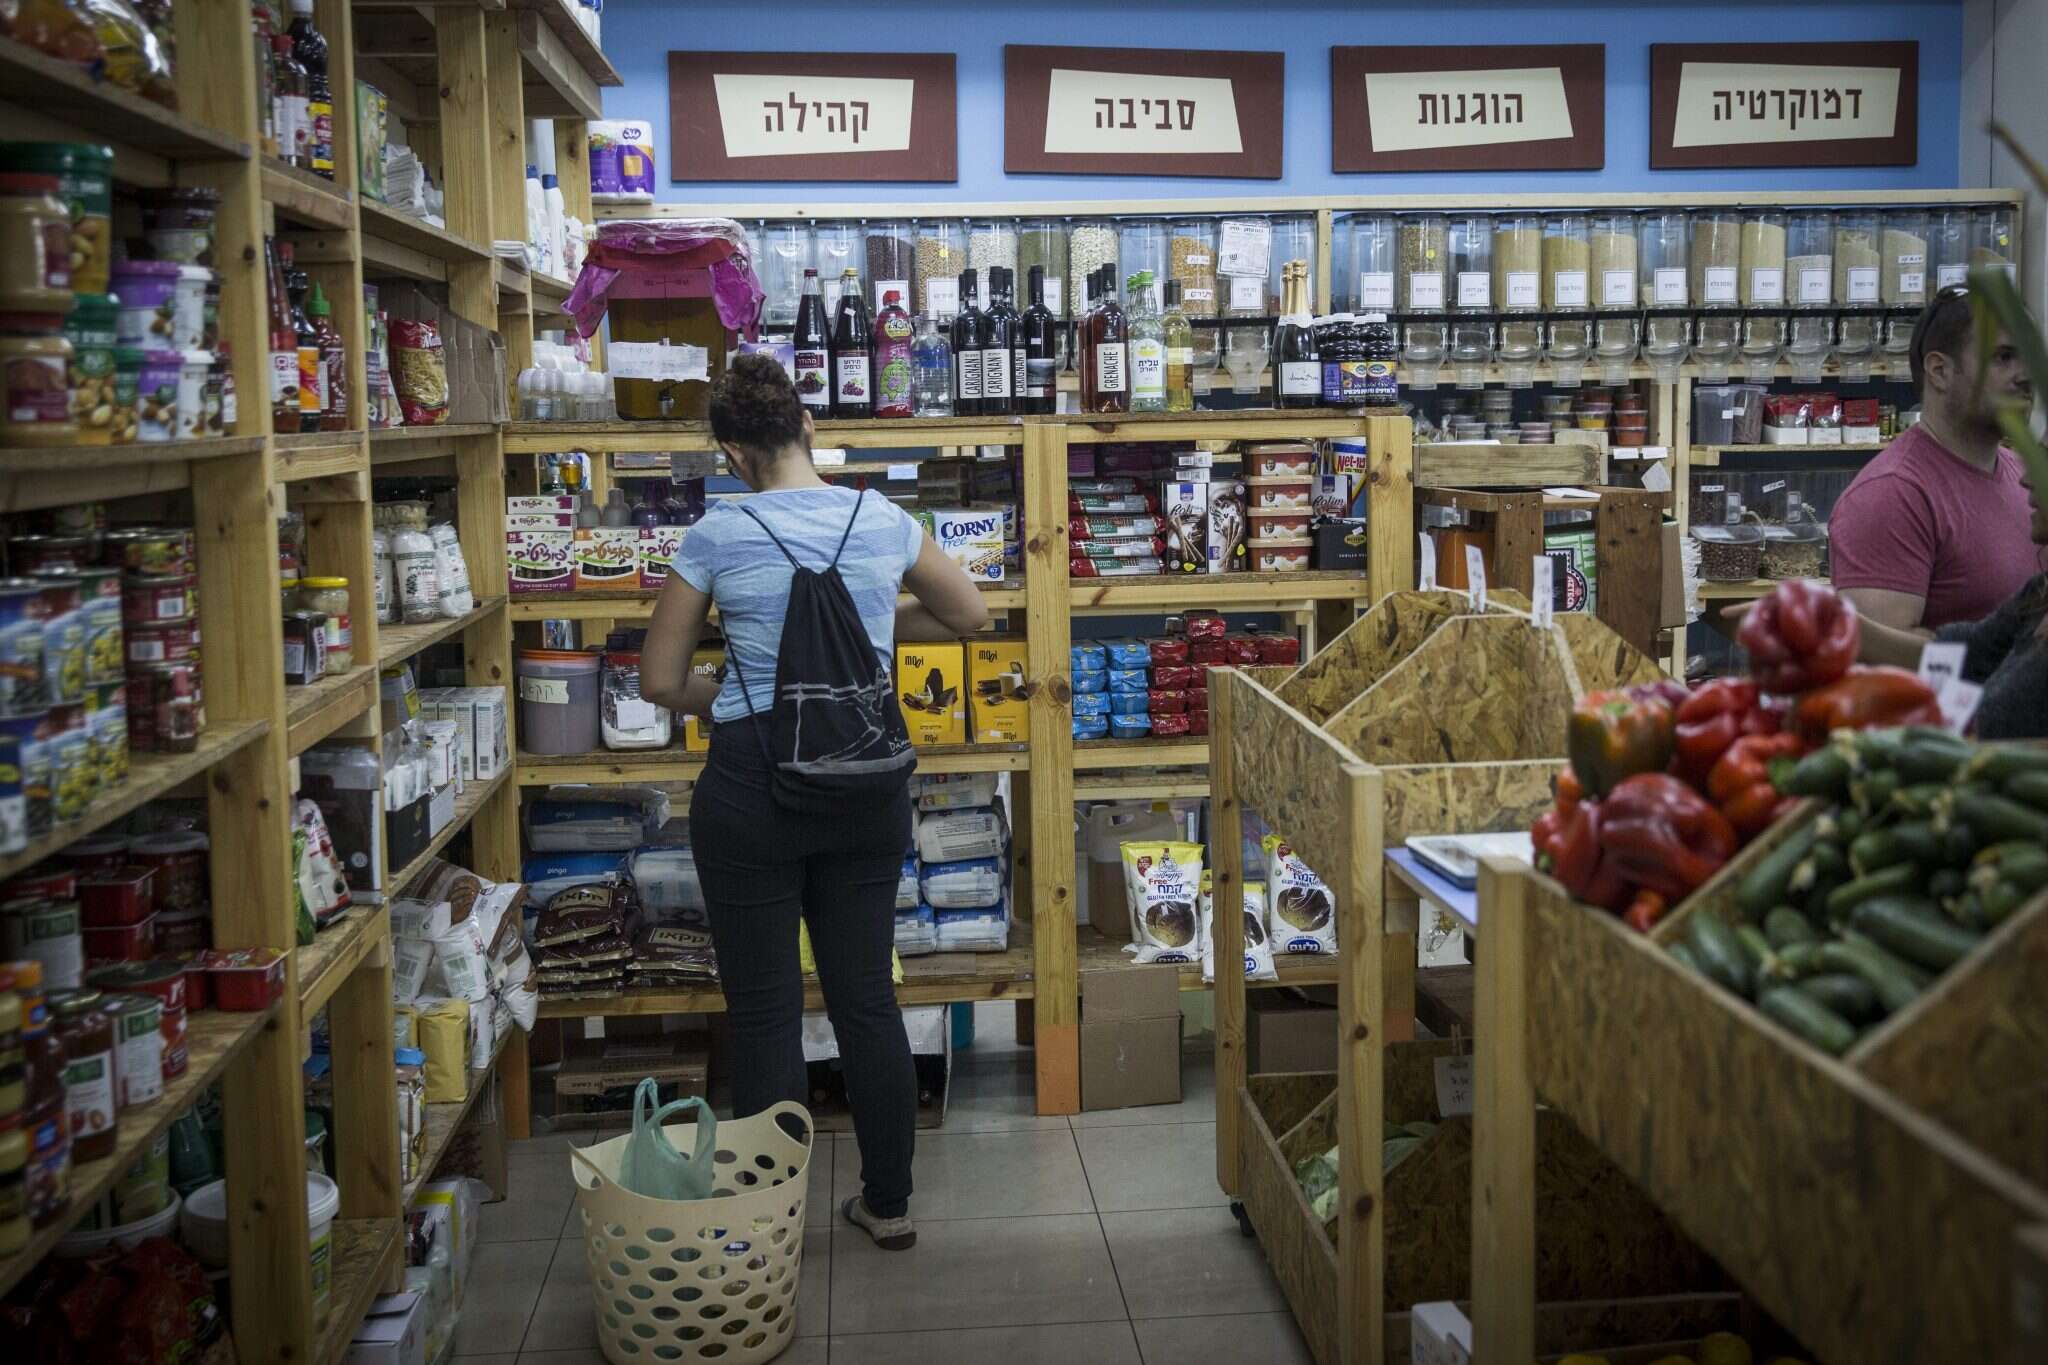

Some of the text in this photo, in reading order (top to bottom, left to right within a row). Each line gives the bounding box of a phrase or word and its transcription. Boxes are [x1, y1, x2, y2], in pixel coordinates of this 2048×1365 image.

[763, 91, 869, 143] קהילה
[1094, 97, 1196, 131] סביבה
[1418, 92, 1523, 125] הוגנות
[1713, 87, 1862, 130] דמוקרטיה
[964, 358, 980, 395] CARIGNAN
[987, 357, 1003, 394] CARIGNAN
[1103, 351, 1119, 389] GRENACHE
[940, 517, 996, 540] CORNY
[941, 536, 968, 552] free
[1148, 878, 1168, 886] Free
[1157, 883, 1183, 895] קמח
[1293, 873, 1317, 884] קמח
[658, 930, 705, 944] קקאו
